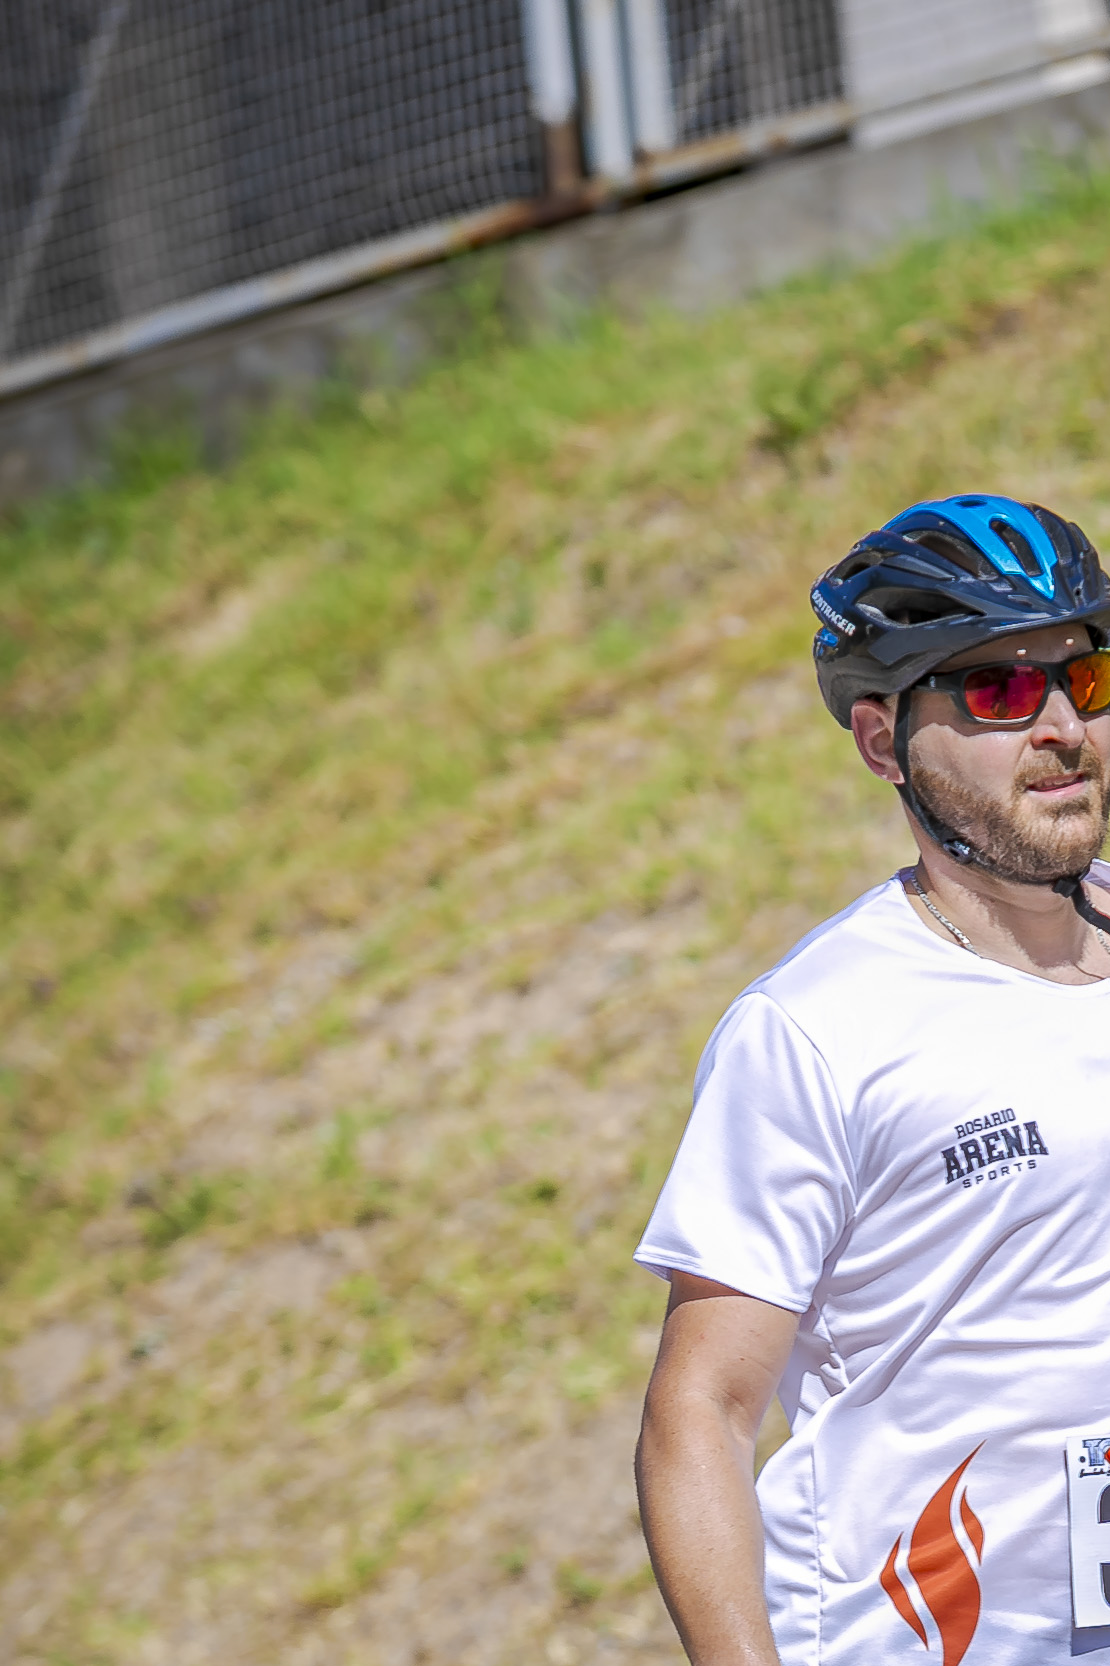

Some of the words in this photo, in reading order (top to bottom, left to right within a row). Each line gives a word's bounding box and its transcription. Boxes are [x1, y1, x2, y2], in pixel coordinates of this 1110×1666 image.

[954, 1108, 1017, 1140] ROSARIO
[941, 1120, 1049, 1185] ARENA
[962, 1159, 1037, 1189] SPORTS
